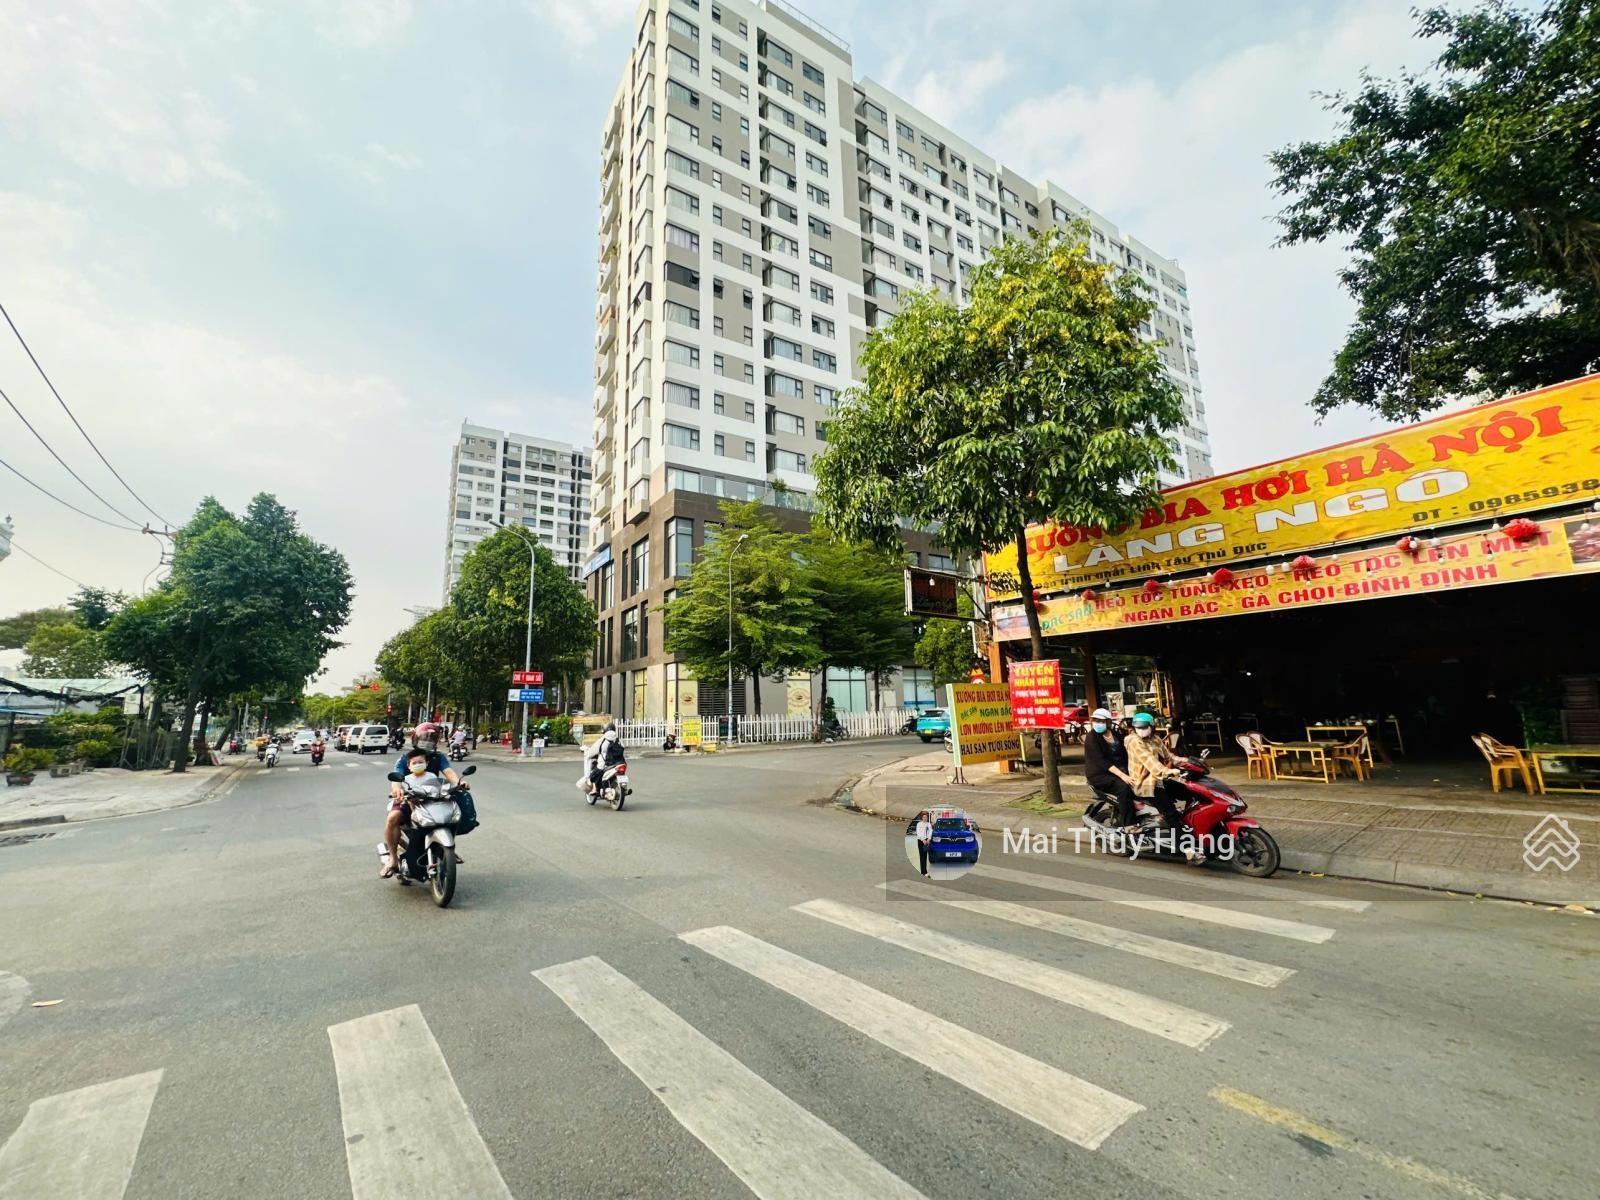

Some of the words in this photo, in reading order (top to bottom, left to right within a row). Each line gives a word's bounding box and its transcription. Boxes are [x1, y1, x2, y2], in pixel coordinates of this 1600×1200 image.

[1140, 497, 1211, 530] BIA
[1220, 469, 1311, 510] HƠI
[1323, 442, 1415, 486] HÀ
[1427, 405, 1567, 462] NỘI
[1053, 522, 1225, 573] LÀNG
[1254, 467, 1469, 534] NGÔ
[1197, 548, 1226, 561] Thủ
[1124, 606, 1174, 624] NGAN
[1278, 585, 1335, 604] CHỌI
[1420, 563, 1498, 587] ĐỊNH
[980, 708, 999, 718] NGAN
